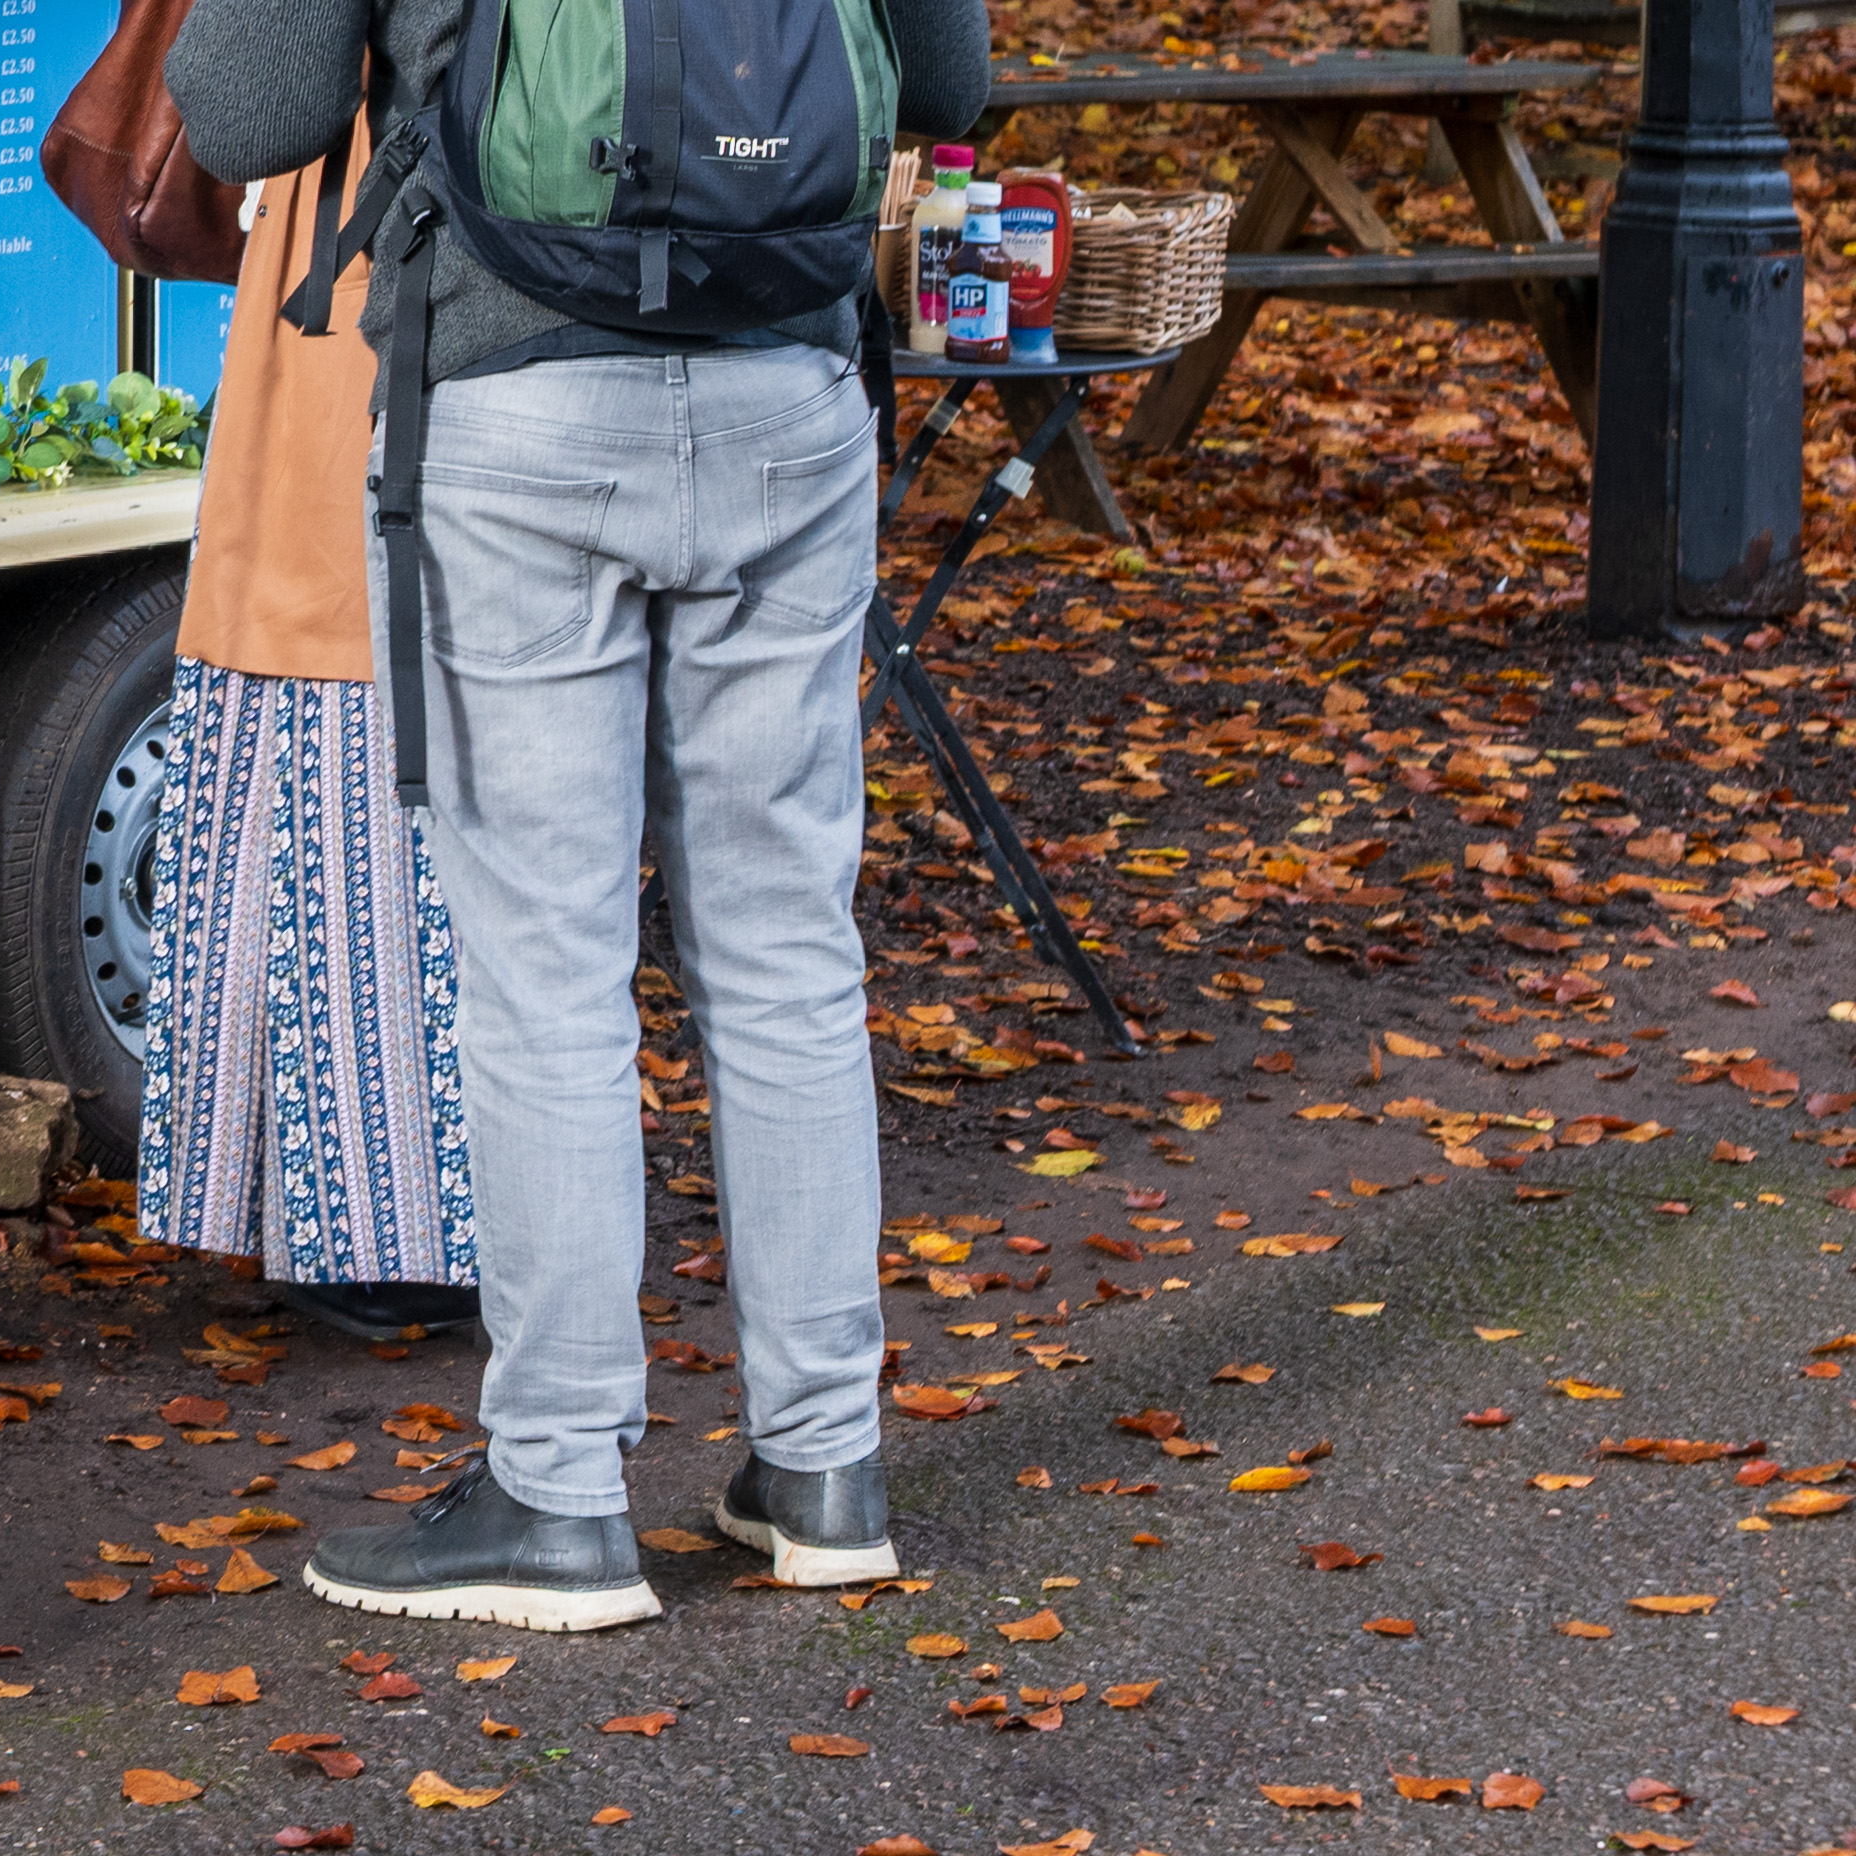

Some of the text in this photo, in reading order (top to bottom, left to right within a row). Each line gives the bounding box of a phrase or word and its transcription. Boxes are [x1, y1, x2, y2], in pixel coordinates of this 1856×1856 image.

[1, 27, 36, 47] £2.50
[0, 57, 36, 76] £2.50
[0, 86, 35, 106] £2.50
[0, 116, 35, 136] £2.50
[0, 146, 35, 166] £2.50
[954, 287, 985, 308] HP
